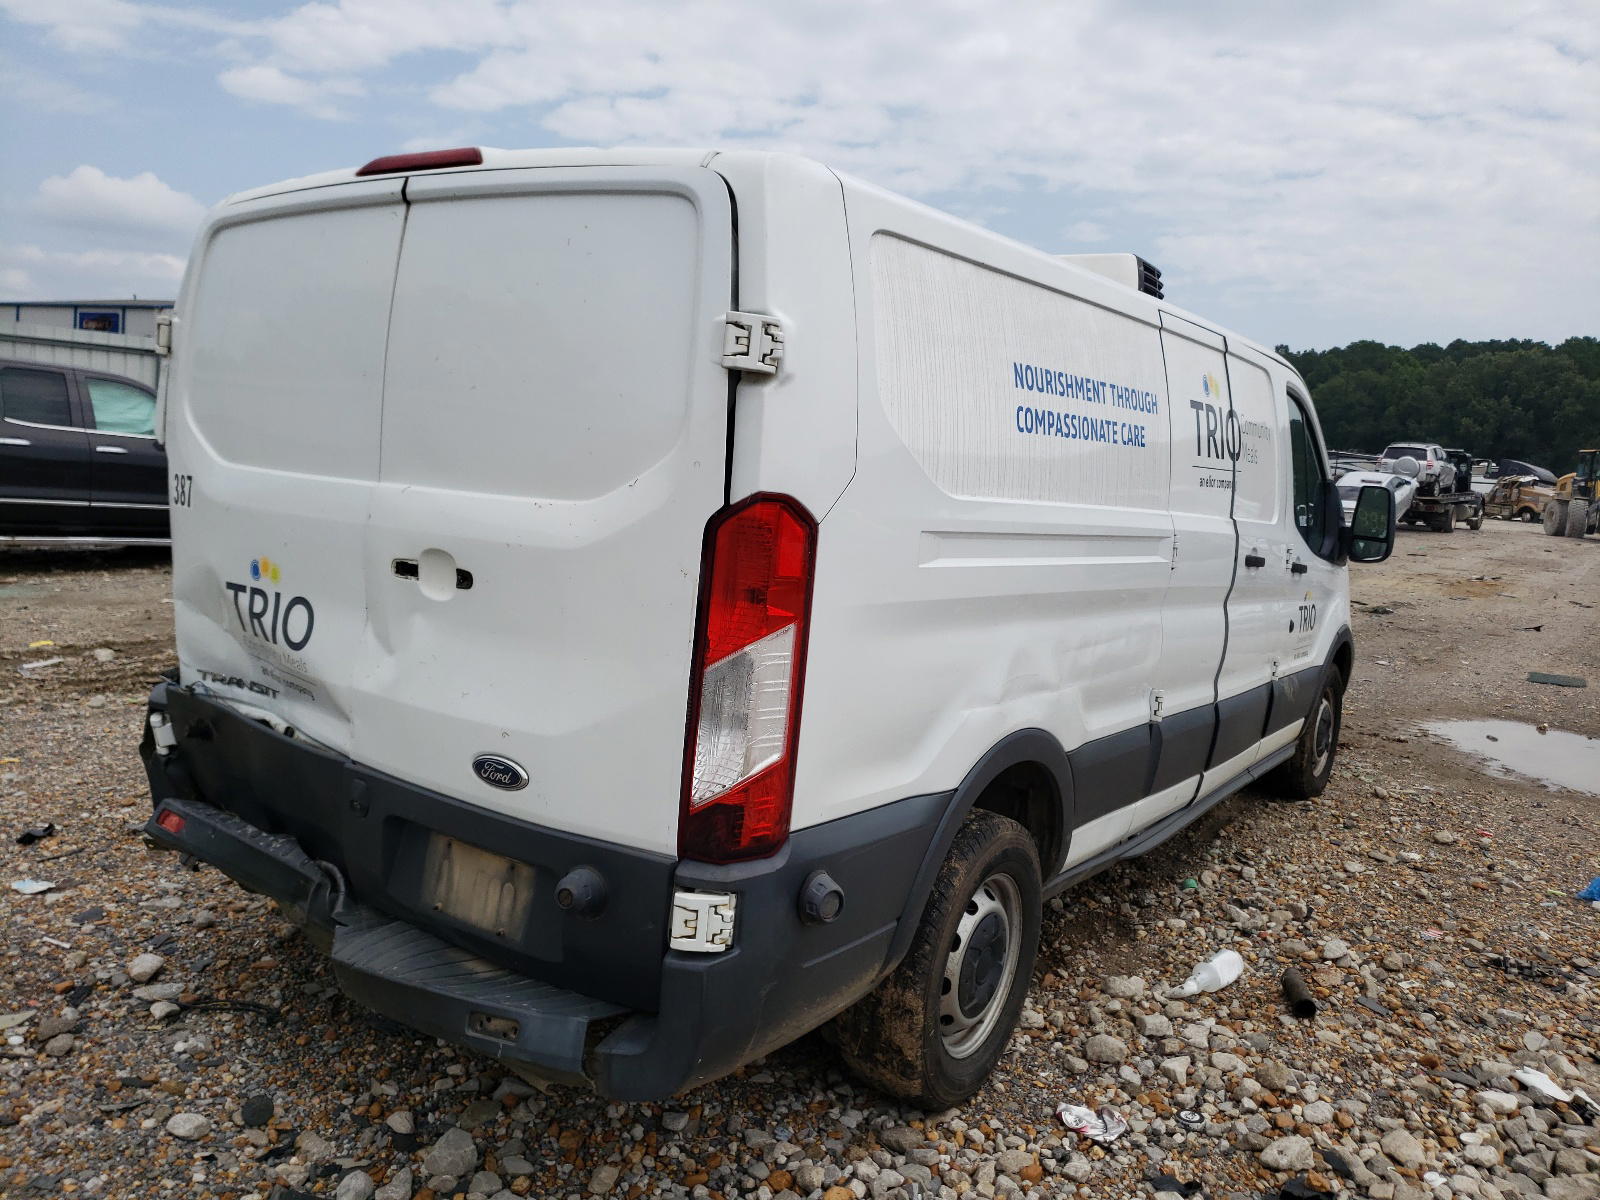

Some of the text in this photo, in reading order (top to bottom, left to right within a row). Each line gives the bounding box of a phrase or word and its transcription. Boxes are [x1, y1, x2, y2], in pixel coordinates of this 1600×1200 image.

[1013, 362, 1158, 415] NOURISHMENT THROUGH
[1016, 405, 1146, 447] COMPASSIONATE CARE
[1190, 399, 1241, 461] TRIO
[174, 473, 193, 507] 387
[226, 581, 315, 651] TRIO
[1299, 603, 1316, 633] TRIO
[481, 761, 511, 784] Ford
